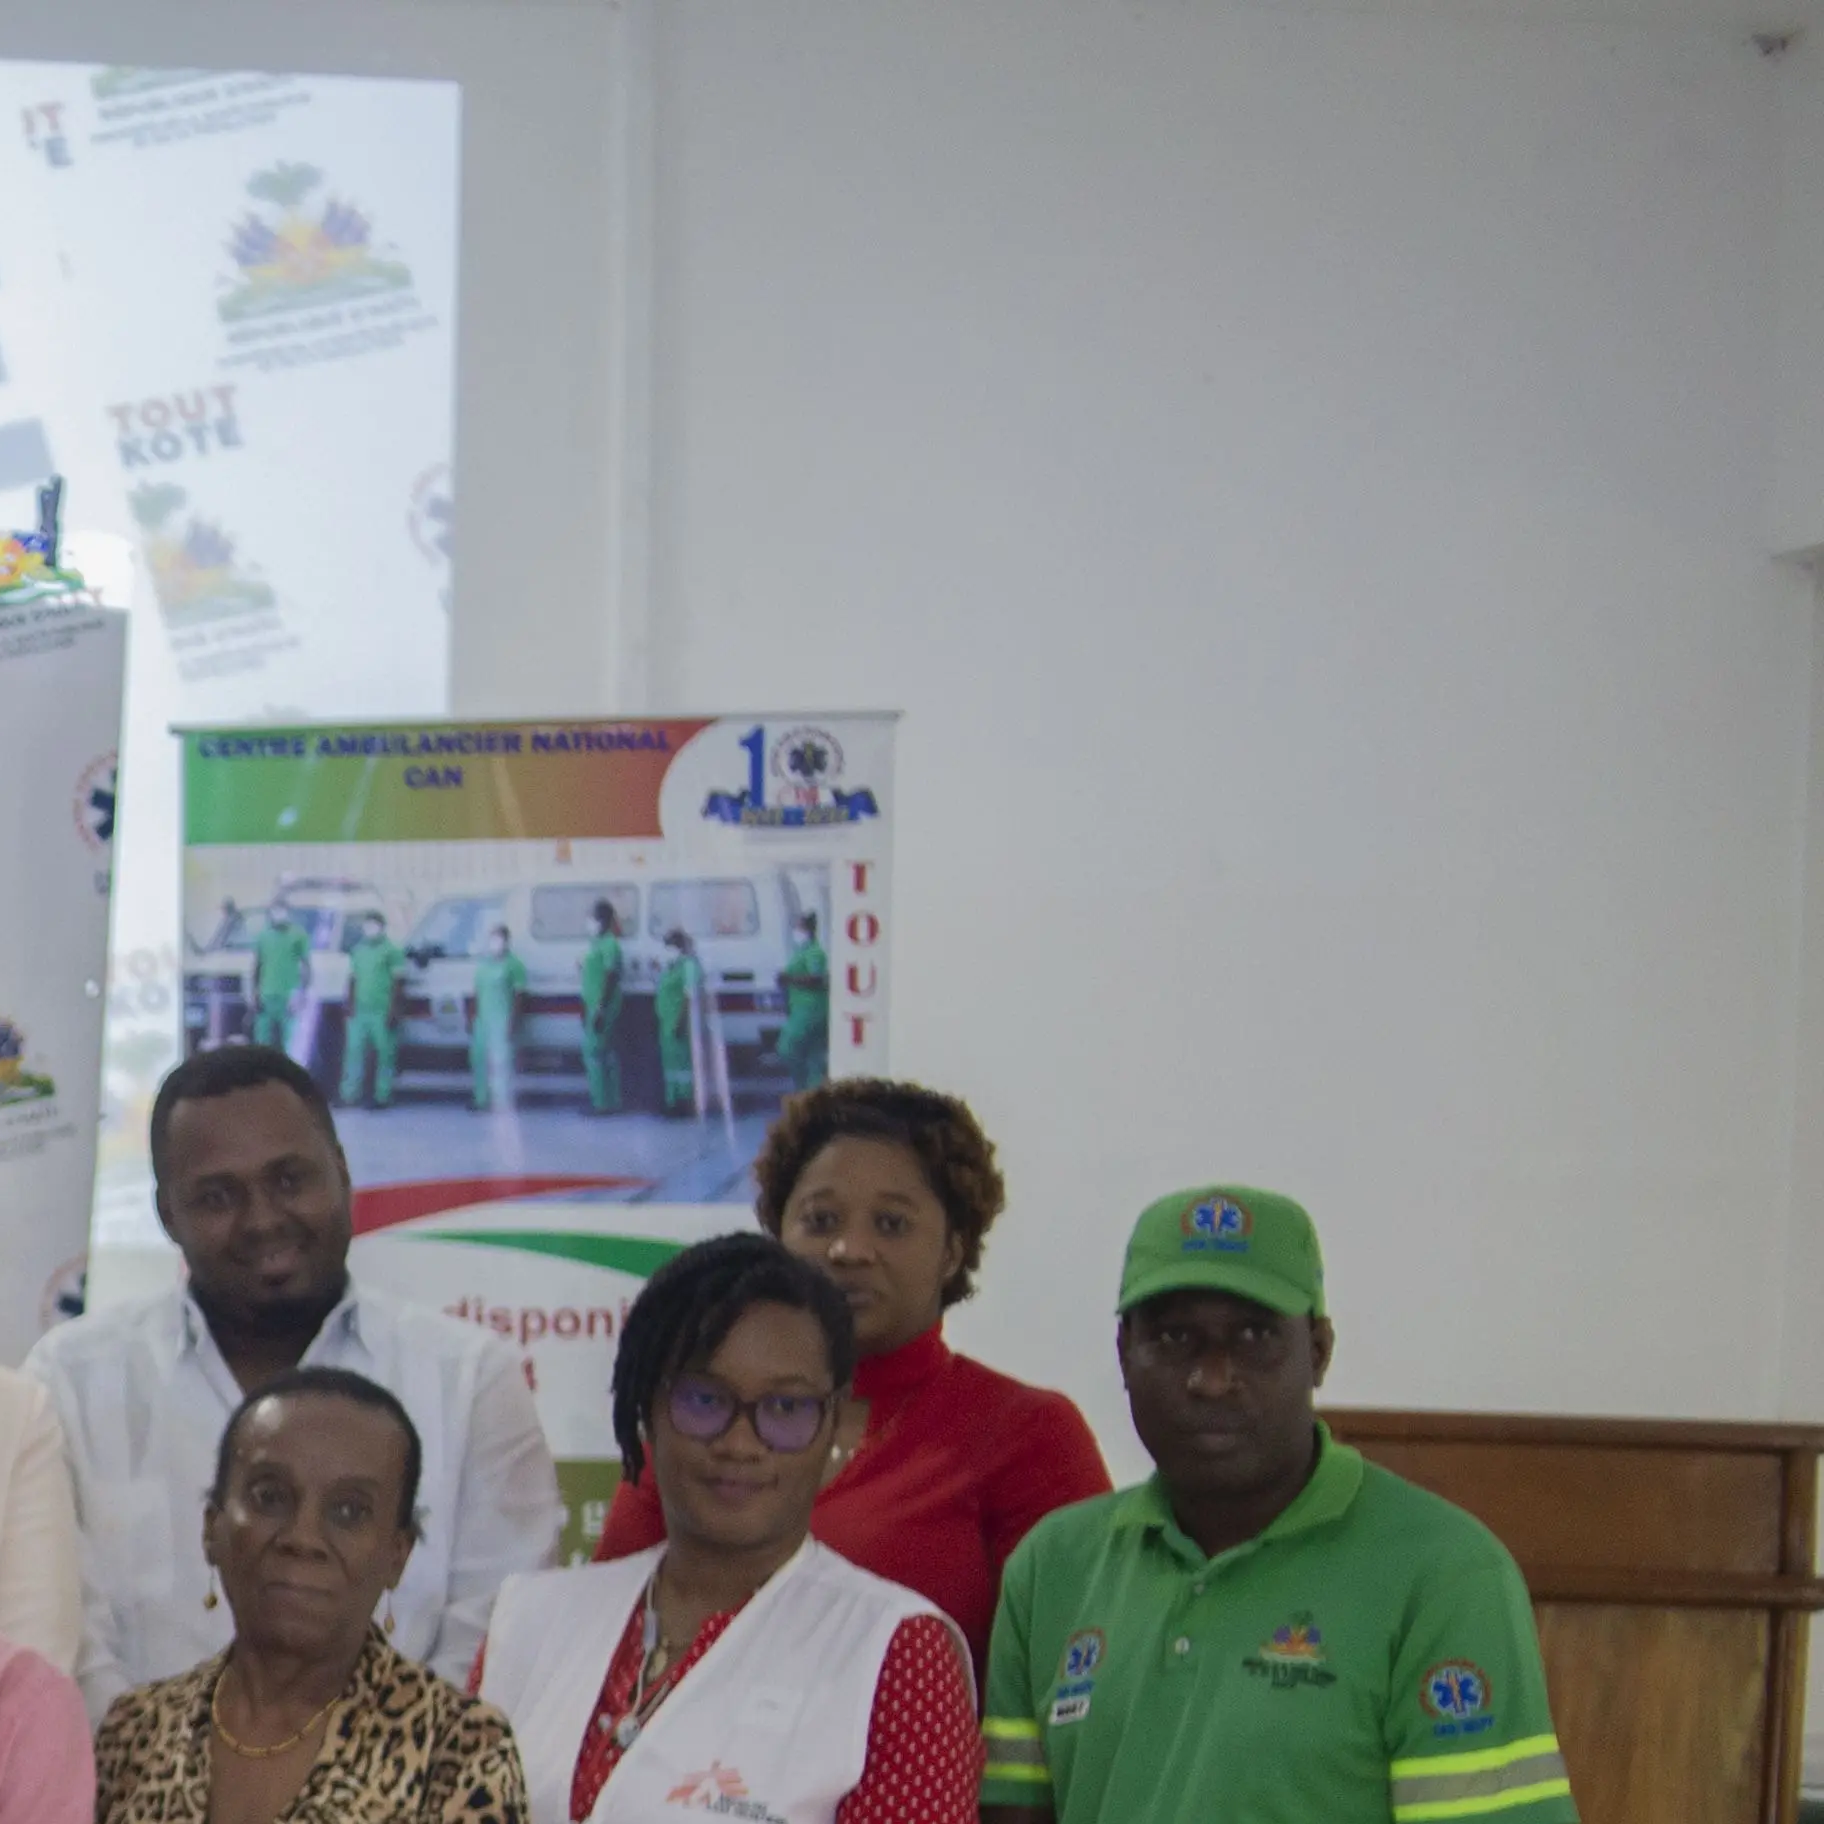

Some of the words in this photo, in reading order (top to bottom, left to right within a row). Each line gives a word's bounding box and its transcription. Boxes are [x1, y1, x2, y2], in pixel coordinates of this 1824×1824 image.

[104, 382, 238, 435] TOUT
[198, 733, 306, 758] CENTRE
[315, 730, 522, 757] AMBULANCIER
[532, 727, 670, 754] NATIONAL
[402, 765, 463, 789] CAN
[843, 859, 880, 1047] TOUT
